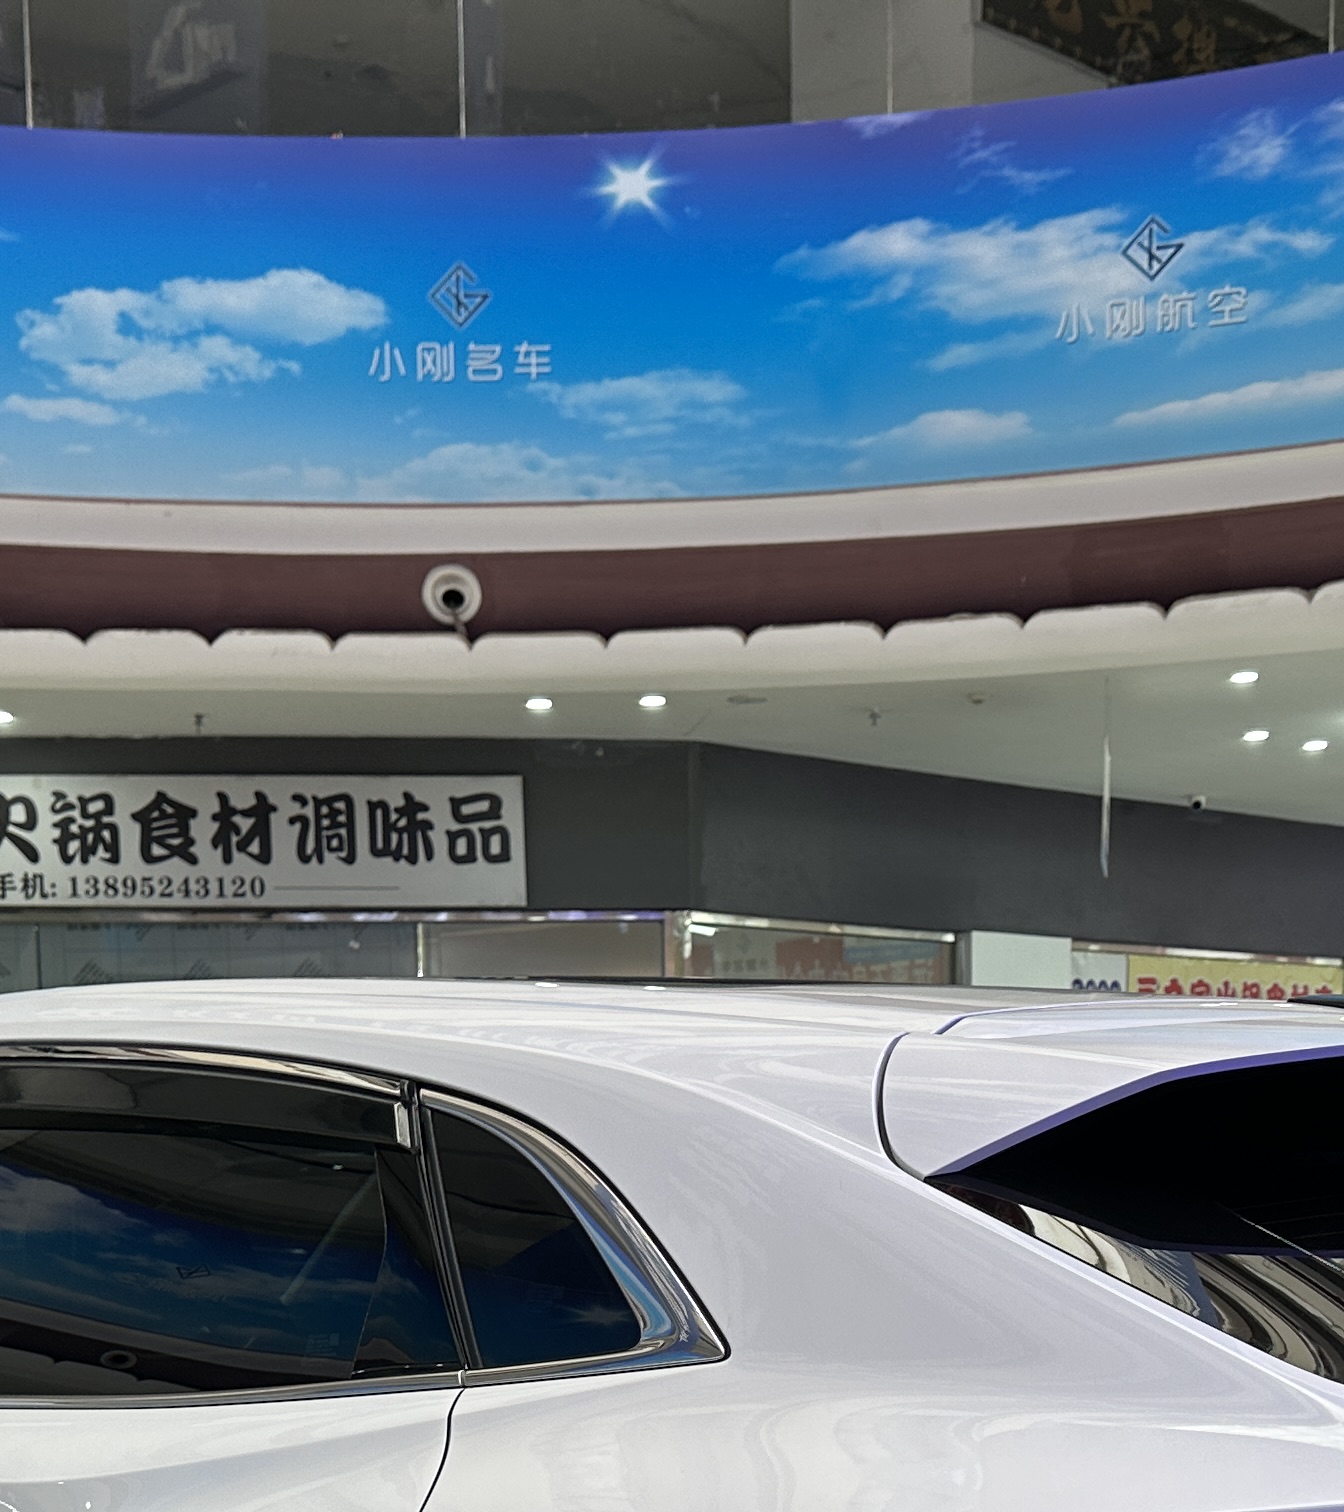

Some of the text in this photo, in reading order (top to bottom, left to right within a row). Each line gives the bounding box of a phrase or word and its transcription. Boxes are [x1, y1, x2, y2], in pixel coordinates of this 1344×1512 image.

[1056, 284, 1248, 343] 小刚航空
[368, 341, 552, 383] 小刚名车
[68, 876, 266, 900] 13895243120
